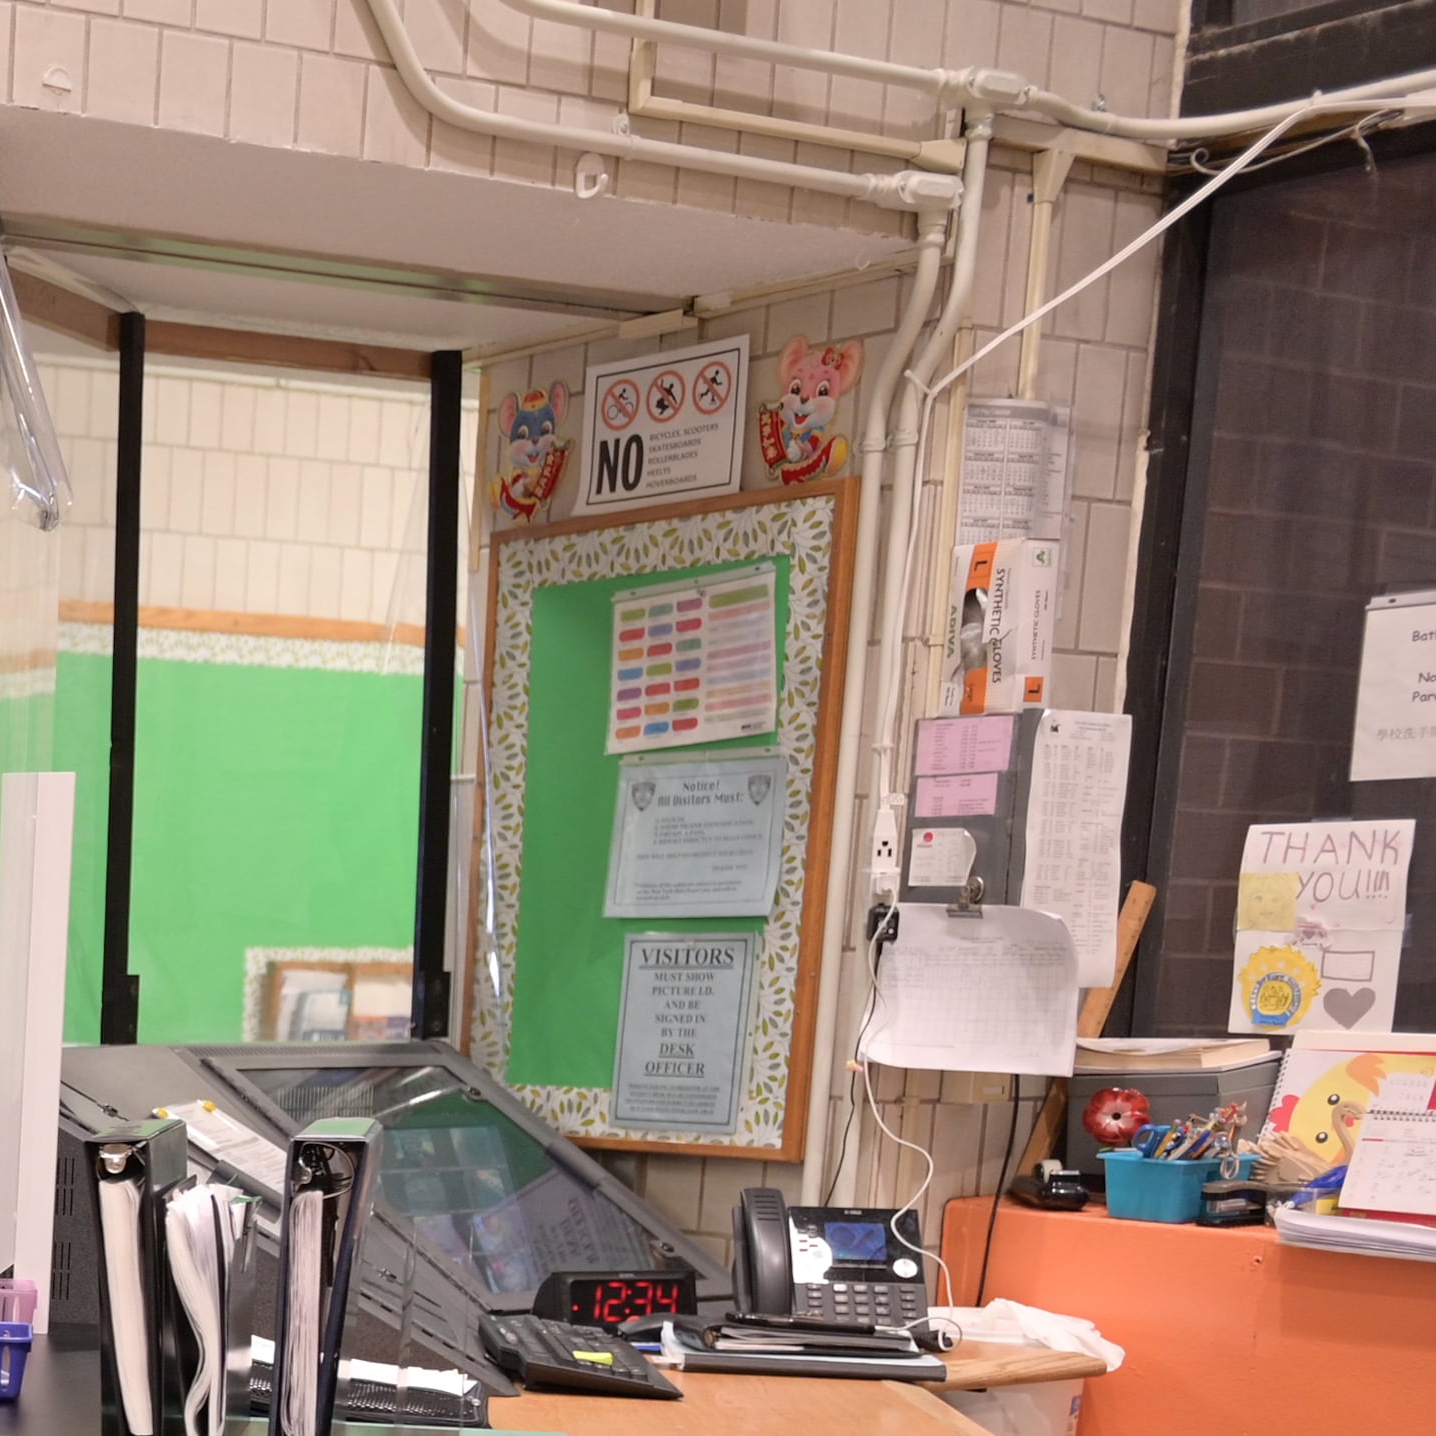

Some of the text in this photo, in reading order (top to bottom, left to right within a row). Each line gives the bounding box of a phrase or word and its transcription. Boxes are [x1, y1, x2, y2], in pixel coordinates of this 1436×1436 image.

[595, 433, 644, 496] NO
[989, 568, 1006, 636] SYNTHETIC
[947, 605, 958, 659] ADIVA
[1031, 589, 1041, 660] SYNTHETIC GLOVES
[1260, 829, 1401, 865] THANK
[641, 948, 735, 966] VISITORS
[654, 972, 714, 982] MUST SHOW
[652, 986, 696, 996] PICTURE
[665, 1000, 700, 1010] AND BE
[655, 1014, 706, 1024] SIGNED IN
[661, 1028, 697, 1038] BY THE
[659, 1043, 695, 1056] DESK
[645, 1061, 705, 1076] OFFICER
[593, 1281, 678, 1322] 12:34
